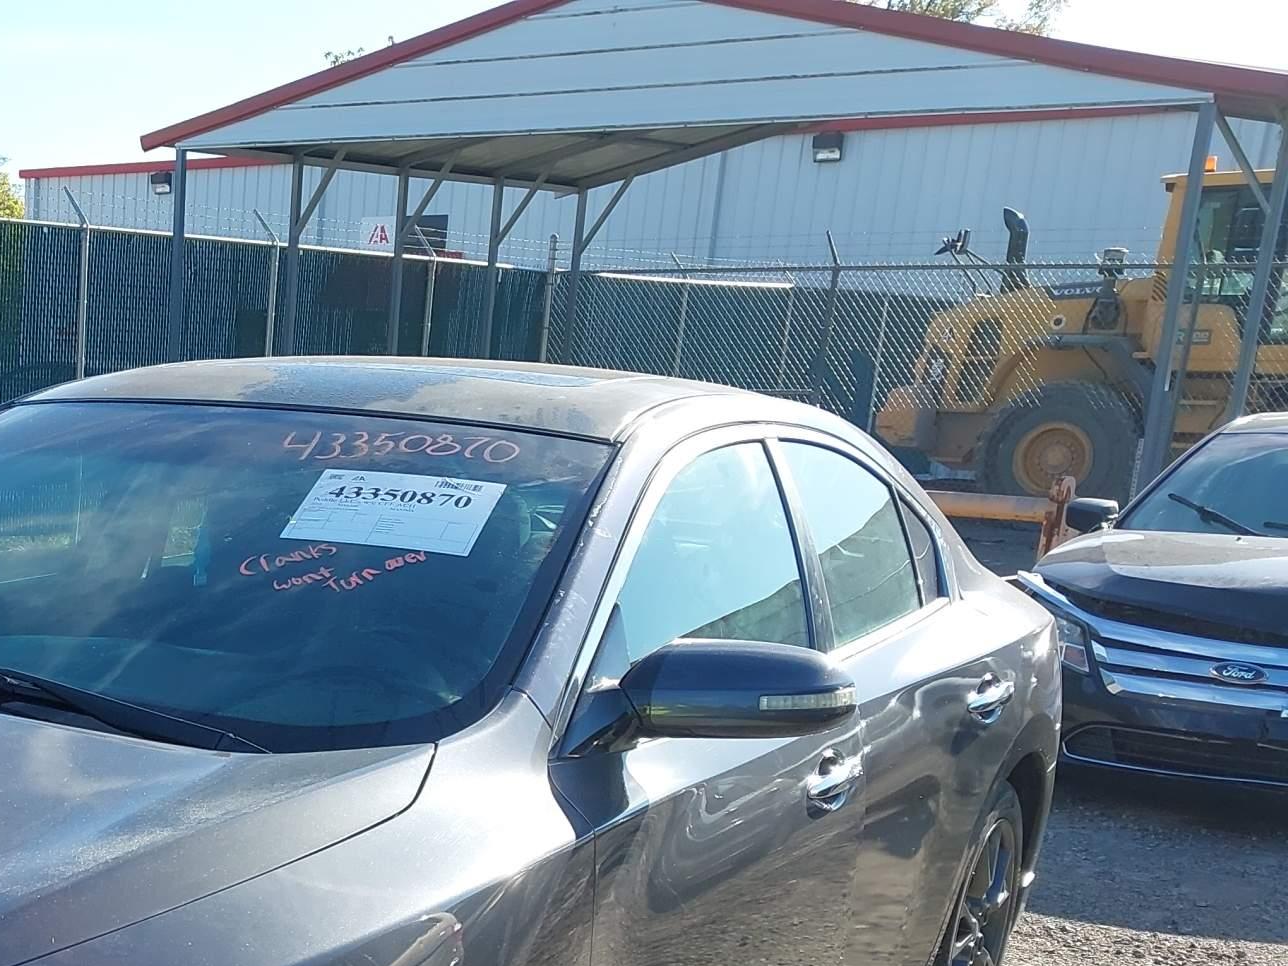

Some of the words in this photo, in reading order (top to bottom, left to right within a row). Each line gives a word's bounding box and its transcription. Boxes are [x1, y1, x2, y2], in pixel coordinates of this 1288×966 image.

[282, 431, 521, 464] 43350870
[328, 485, 473, 509] 43350870
[239, 543, 337, 576] Cranks
[1222, 664, 1257, 680] Ford
